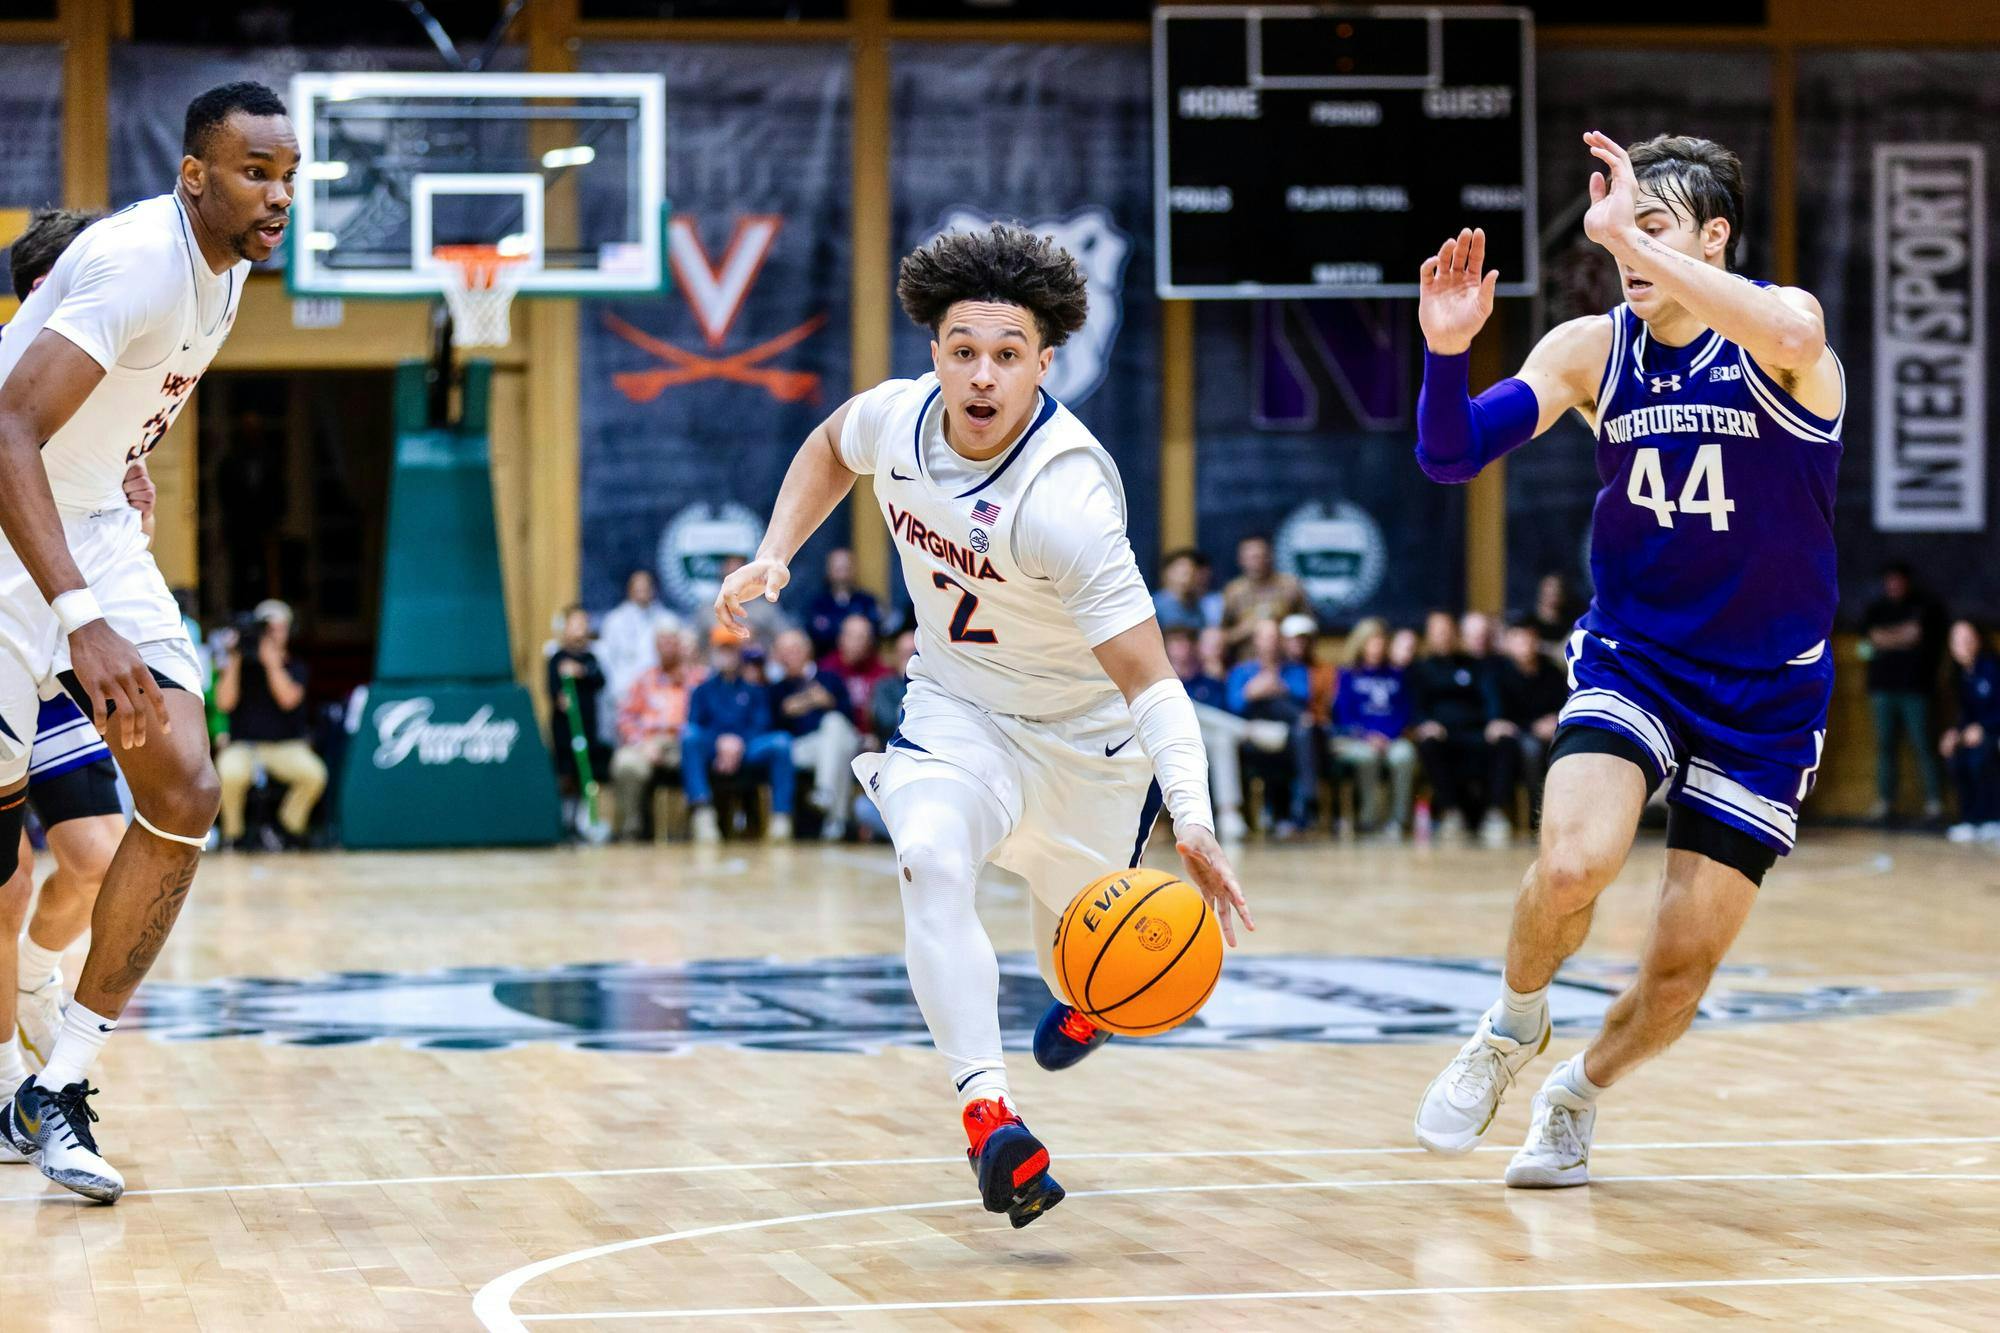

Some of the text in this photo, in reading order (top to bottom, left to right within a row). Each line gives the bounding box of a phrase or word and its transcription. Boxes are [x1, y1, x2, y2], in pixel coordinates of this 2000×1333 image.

[1179, 88, 1260, 118] HOME
[1424, 87, 1512, 117] GUEST
[1627, 444, 1735, 531] 44
[888, 502, 1007, 582] VIRGINIA
[931, 571, 999, 644] 2
[1083, 878, 1131, 932] EVO
